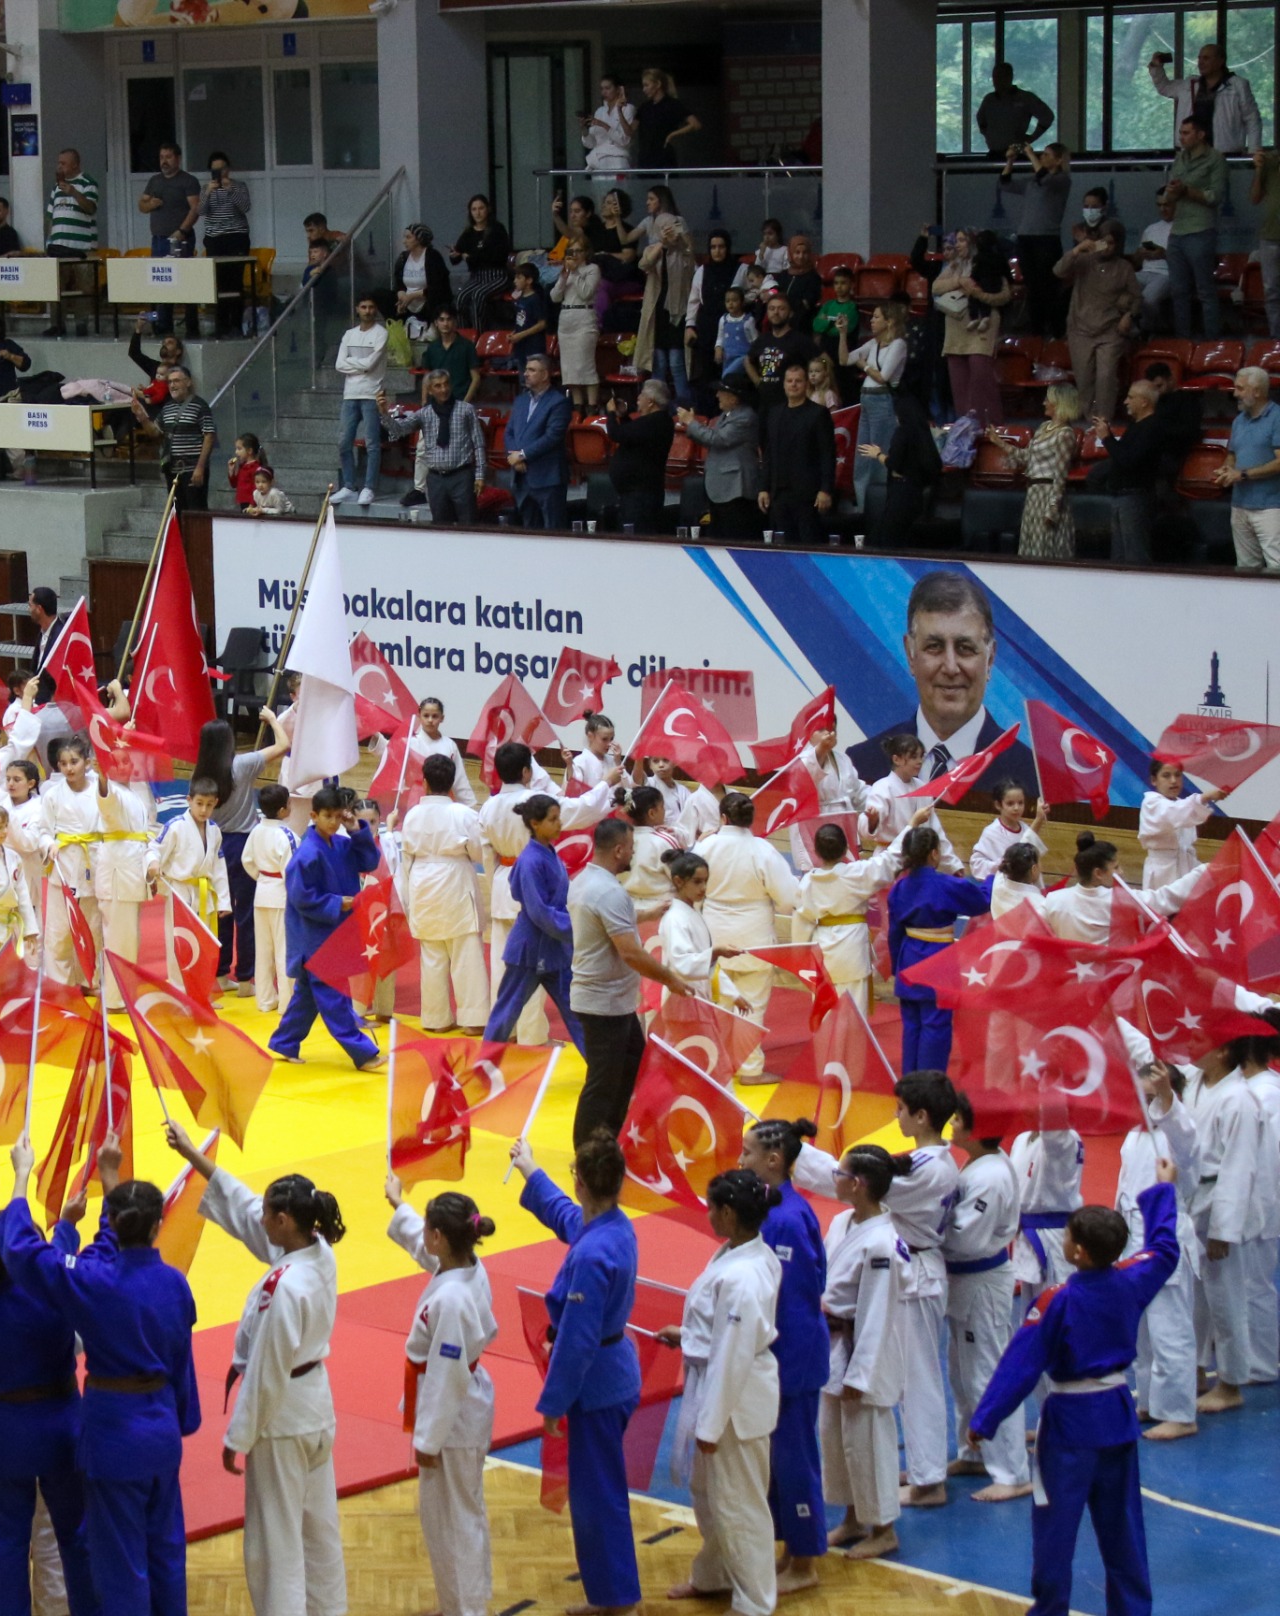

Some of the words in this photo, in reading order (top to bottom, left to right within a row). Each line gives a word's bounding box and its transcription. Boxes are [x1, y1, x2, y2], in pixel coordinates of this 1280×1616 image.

[0, 265, 19, 273] BASIN
[151, 266, 172, 274] BASIN
[152, 274, 173, 282] PRESS
[27, 411, 48, 419] BASIN
[27, 420, 48, 428] PRESS
[258, 578, 466, 625] Müsakalara
[475, 595, 583, 635] katılan
[348, 631, 465, 672] kımlara
[474, 642, 618, 684] başalar
[627, 655, 752, 698] dilerim.
